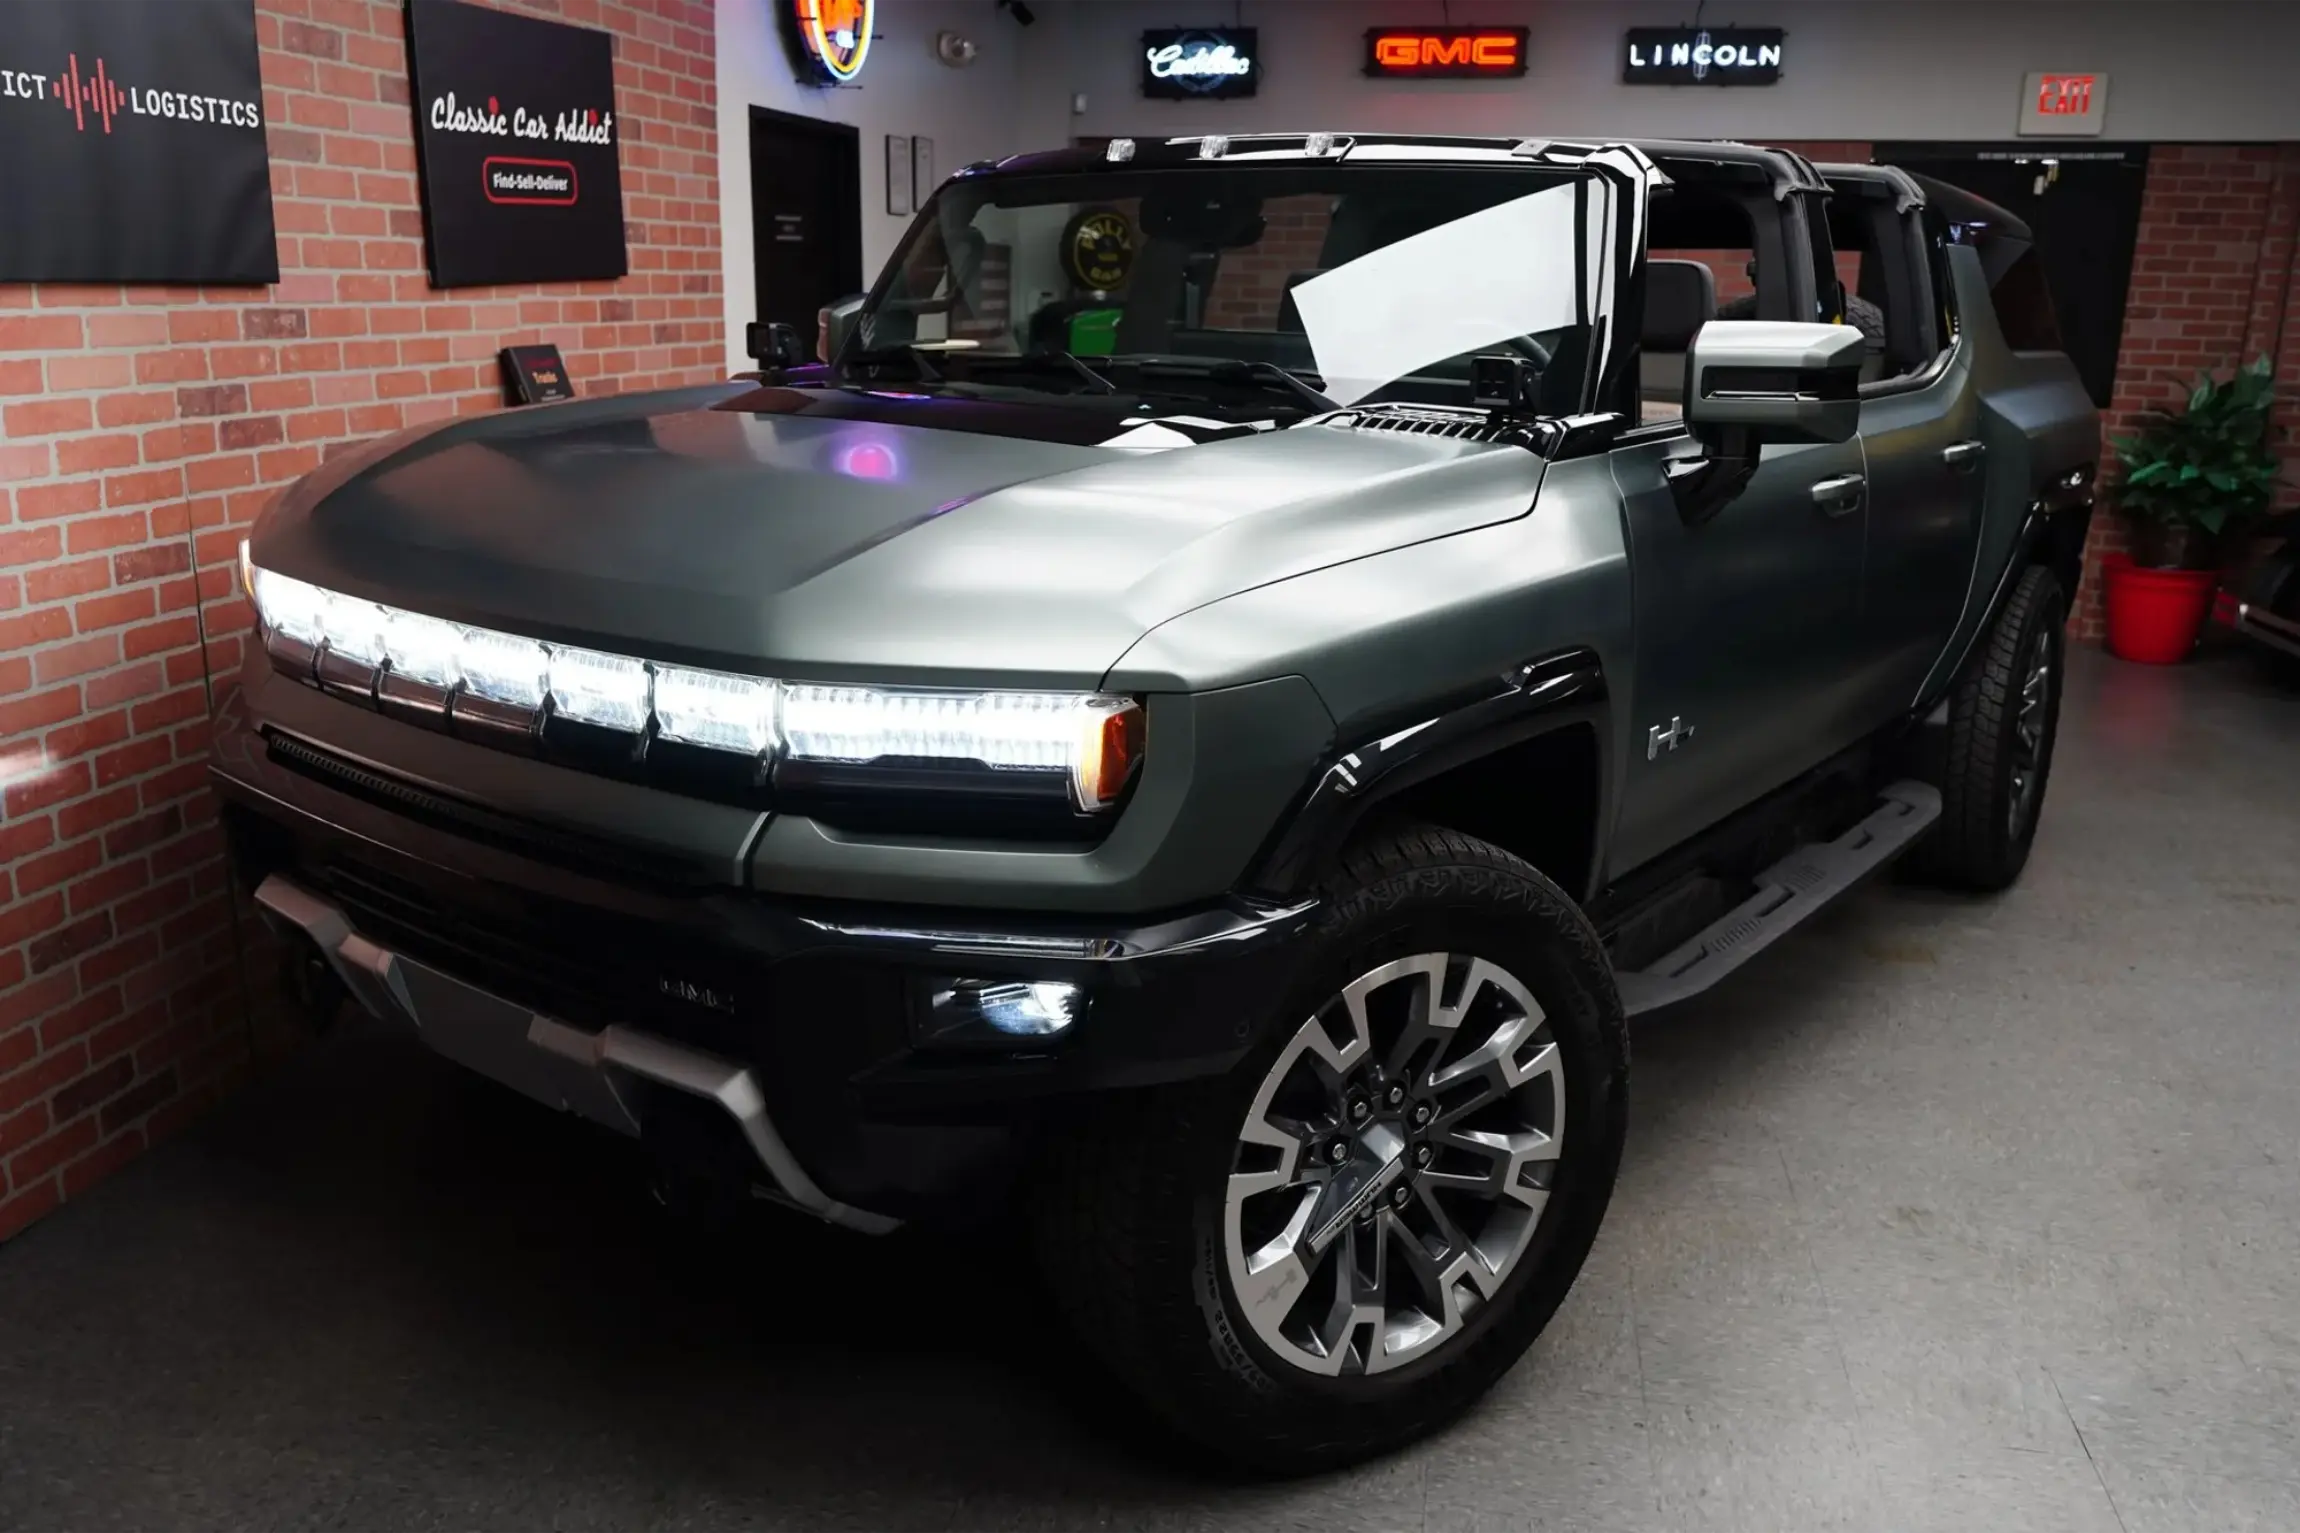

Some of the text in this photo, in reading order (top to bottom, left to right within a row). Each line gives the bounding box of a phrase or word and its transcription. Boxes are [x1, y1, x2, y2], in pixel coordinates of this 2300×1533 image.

[1147, 44, 1250, 78] Cadillac
[1376, 37, 1517, 66] GMC
[1630, 41, 1781, 70] LINCOLN
[130, 86, 260, 129] LOGISTICS
[2037, 74, 2096, 116] EXIT
[430, 92, 612, 146] Classic Car Addict
[492, 172, 568, 192] Find-Sell-Deliver
